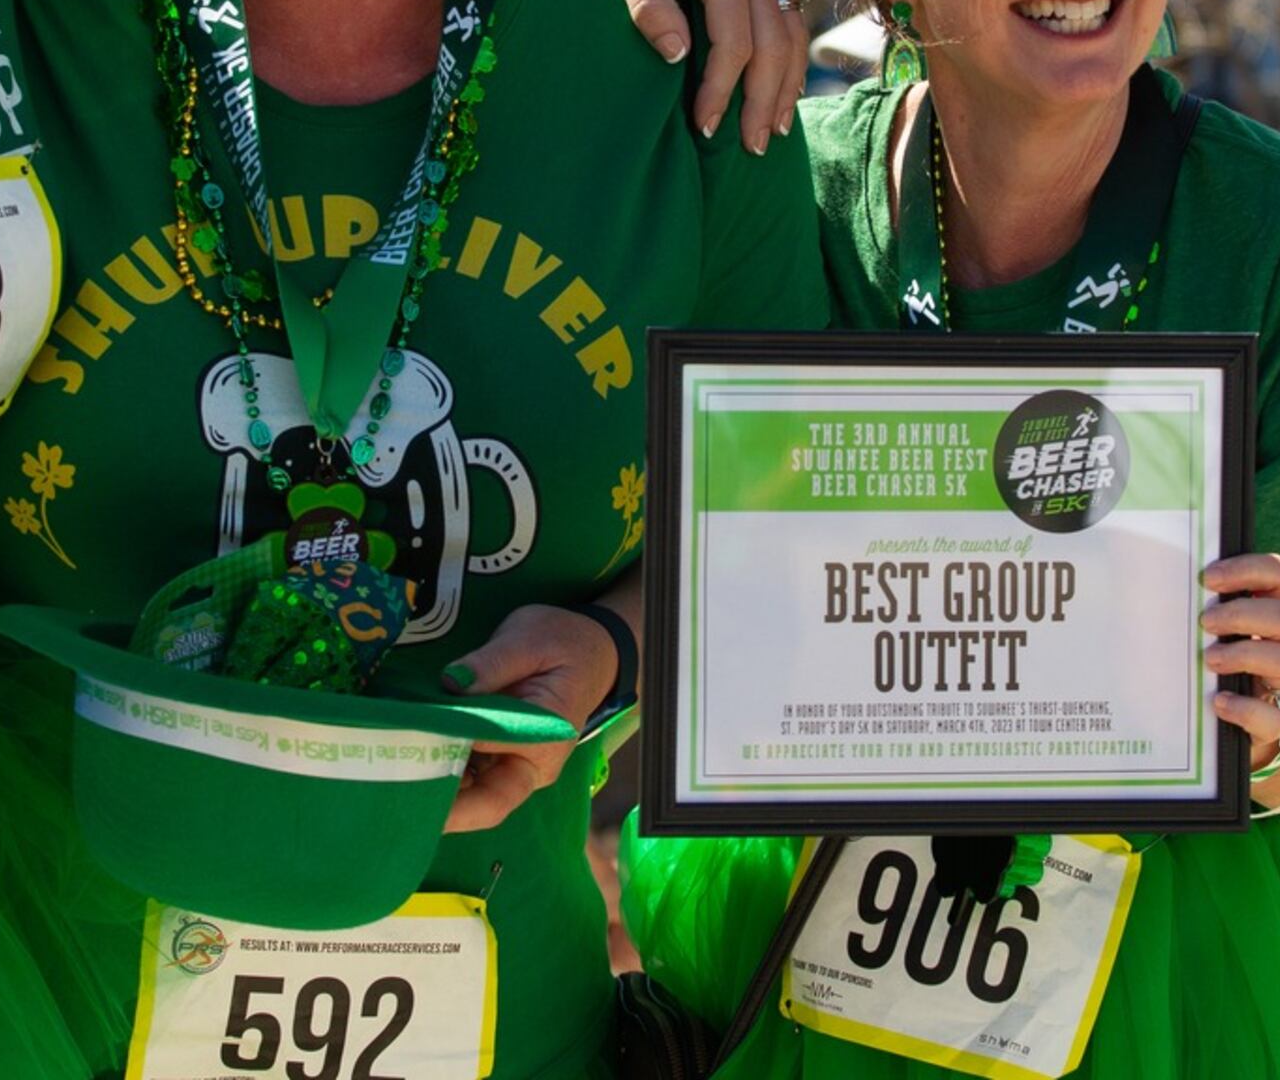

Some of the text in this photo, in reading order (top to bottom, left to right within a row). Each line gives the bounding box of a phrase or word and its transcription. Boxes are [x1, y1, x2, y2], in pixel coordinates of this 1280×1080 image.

[212, 37, 250, 85] 5K
[370, 204, 418, 266] BEER
[245, 194, 380, 265] UP
[434, 215, 634, 401] IVER
[808, 423, 970, 446] THE 3RD ANNUAL
[791, 448, 988, 472] SUWANEE BEER FEST
[1007, 434, 1116, 480] BEER
[811, 474, 967, 497] BEER CHASER 5K
[1016, 467, 1116, 500] CHASER
[1044, 493, 1090, 516] 5K
[293, 533, 361, 561] BEER
[865, 535, 1034, 558] presents the award of
[824, 560, 1076, 623] BEST GROUP
[874, 630, 1027, 693] OUTFIT
[796, 704, 825, 718] HONOR
[828, 703, 838, 717] OF
[841, 703, 863, 717] YOUR
[866, 703, 924, 717] OUTSTANDING
[926, 702, 960, 716] TRIBUTE
[964, 702, 974, 716] TO
[839, 721, 855, 734] DAY
[858, 721, 869, 734] 5K
[872, 720, 883, 734] ON
[936, 720, 966, 734] MARCH
[991, 719, 1012, 733] 2023
[1015, 719, 1026, 733] AT
[1029, 719, 1052, 733] TOWN
[1055, 719, 1087, 733] CENTER
[742, 740, 1153, 759] WE APPRECIATE YOUR FUN AND ENTHUSIASTIC PARTICIPATION!
[846, 849, 1041, 1004] 906
[240, 938, 278, 952] RESULTS
[279, 939, 294, 952] AT:
[220, 974, 415, 1080] 592
